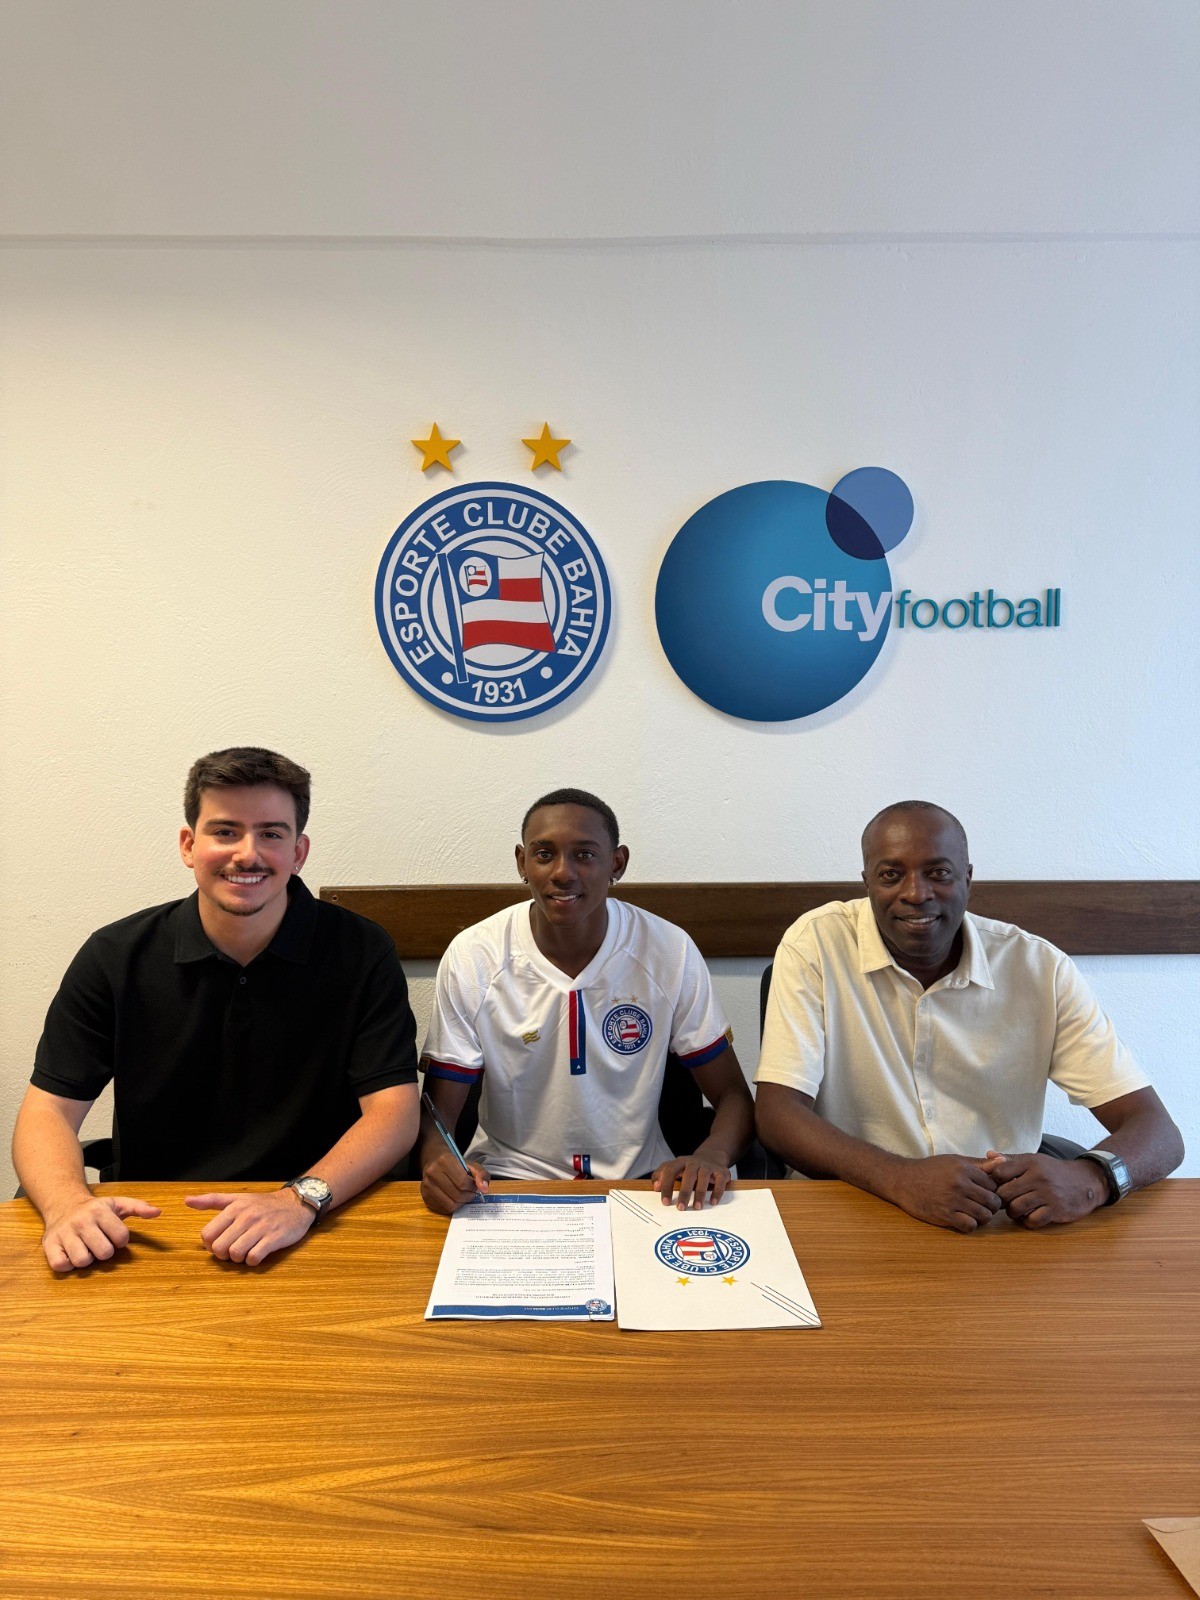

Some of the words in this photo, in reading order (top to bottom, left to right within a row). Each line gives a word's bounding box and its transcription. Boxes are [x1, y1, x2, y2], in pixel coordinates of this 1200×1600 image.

[395, 514, 456, 666] ESPORTE
[463, 501, 571, 556] CLUBE
[557, 557, 594, 658] BAHIA
[761, 575, 893, 642] City
[895, 588, 1061, 628] football
[471, 677, 527, 704] 1931
[607, 1013, 619, 1044] ESPORTE
[619, 1010, 642, 1020] CLUBE
[661, 1239, 676, 1260] BAHIA
[671, 1259, 718, 1273] CLUBE
[719, 1237, 743, 1270] ESPORTE
